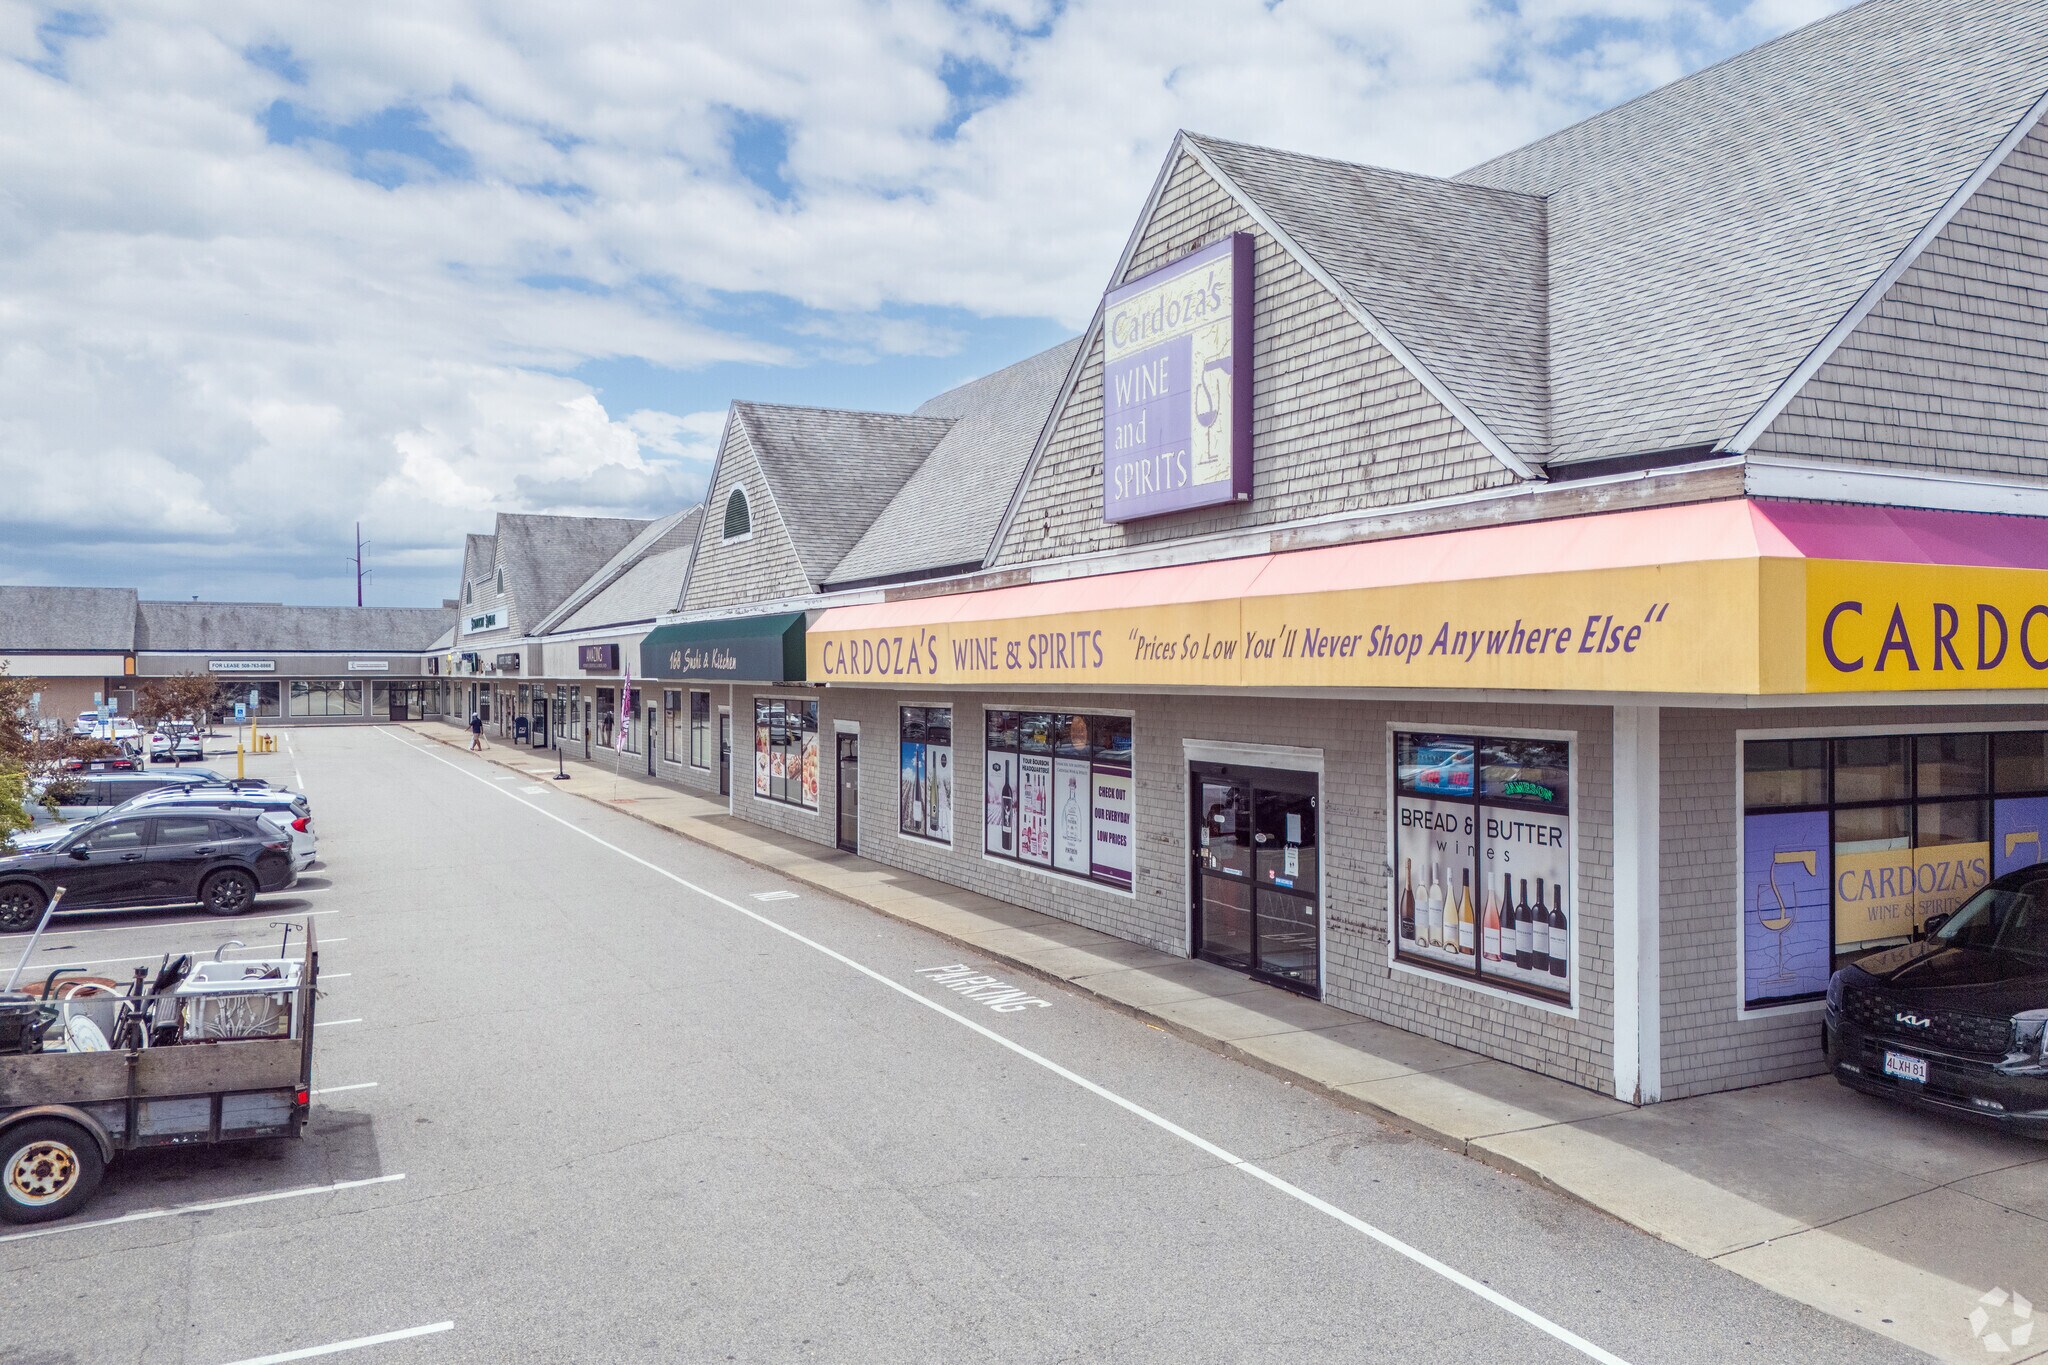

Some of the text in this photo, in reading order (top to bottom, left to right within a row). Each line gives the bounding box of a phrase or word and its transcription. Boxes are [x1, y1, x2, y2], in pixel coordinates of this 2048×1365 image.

[1111, 271, 1222, 349] Cardoza's
[1114, 356, 1170, 408] WINE
[1114, 408, 1147, 451] and
[1114, 449, 1188, 501] SPIRITS
[822, 628, 1104, 675] CARDOZA'S WINE & SPIRITS
[1180, 633, 1200, 661] So
[1202, 632, 1238, 660] Low
[1244, 624, 1298, 660] You'll
[1300, 627, 1363, 658] Never
[1366, 624, 1423, 664] Shop
[1427, 618, 1572, 663] Anywhere
[1822, 600, 2048, 673] CARDO
[682, 647, 702, 673] Sushi
[711, 647, 737, 670] Kitchen
[1022, 757, 1032, 765] YOUR
[1033, 758, 1050, 767] BOURBON
[1098, 785, 1126, 801] CHECK OUT
[1310, 796, 1316, 808] 6
[1504, 781, 1553, 802] JAMESON
[1094, 807, 1131, 825] OUR EVERYDAY
[1401, 808, 1563, 848] BREAD & BUTTER
[1096, 829, 1109, 843] LOW
[1109, 832, 1128, 847] PRICES
[1436, 840, 1510, 862] wines
[1837, 857, 1989, 903] CARDOZA'S
[1867, 903, 1900, 922] WINE
[1904, 902, 1914, 917] &
[914, 963, 1053, 1014] PARKING
[1886, 1057, 1911, 1074] 4LXH
[1912, 1063, 1925, 1078] 81
